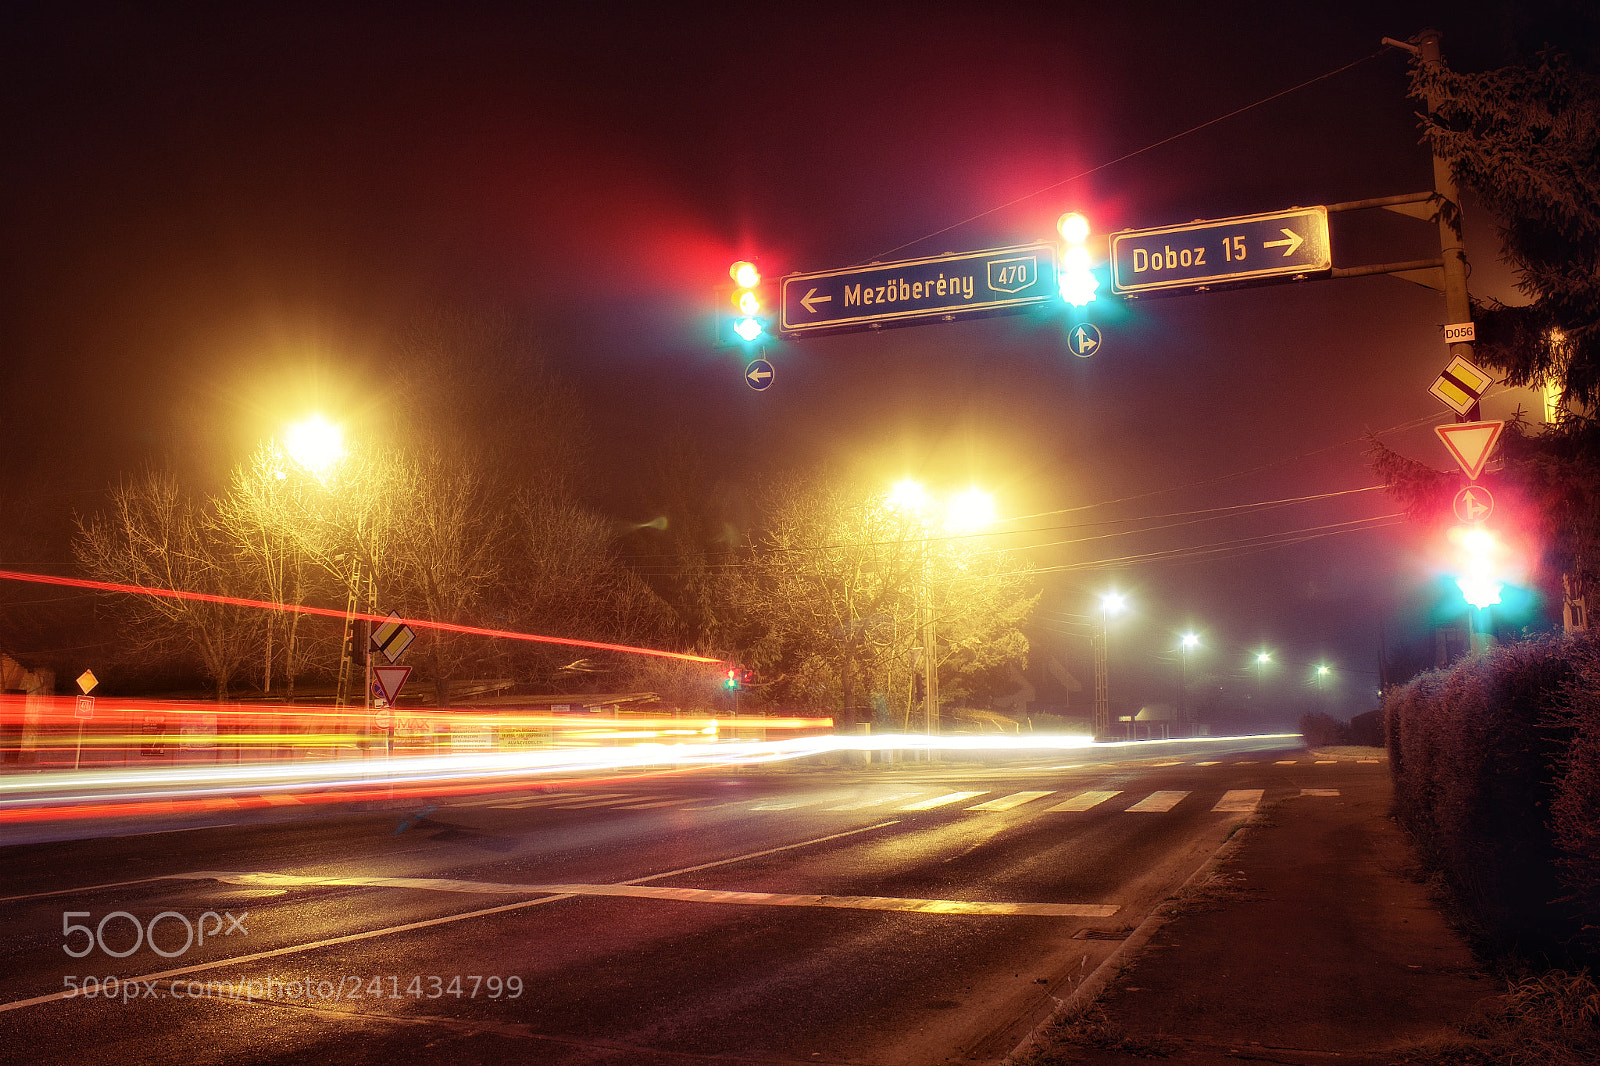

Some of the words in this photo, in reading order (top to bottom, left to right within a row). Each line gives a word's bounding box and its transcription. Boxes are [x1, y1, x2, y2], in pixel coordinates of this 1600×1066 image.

[1133, 245, 1206, 273] Doboz
[1222, 235, 1247, 262] 15
[998, 264, 1027, 285] 470
[1445, 326, 1474, 339] D056
